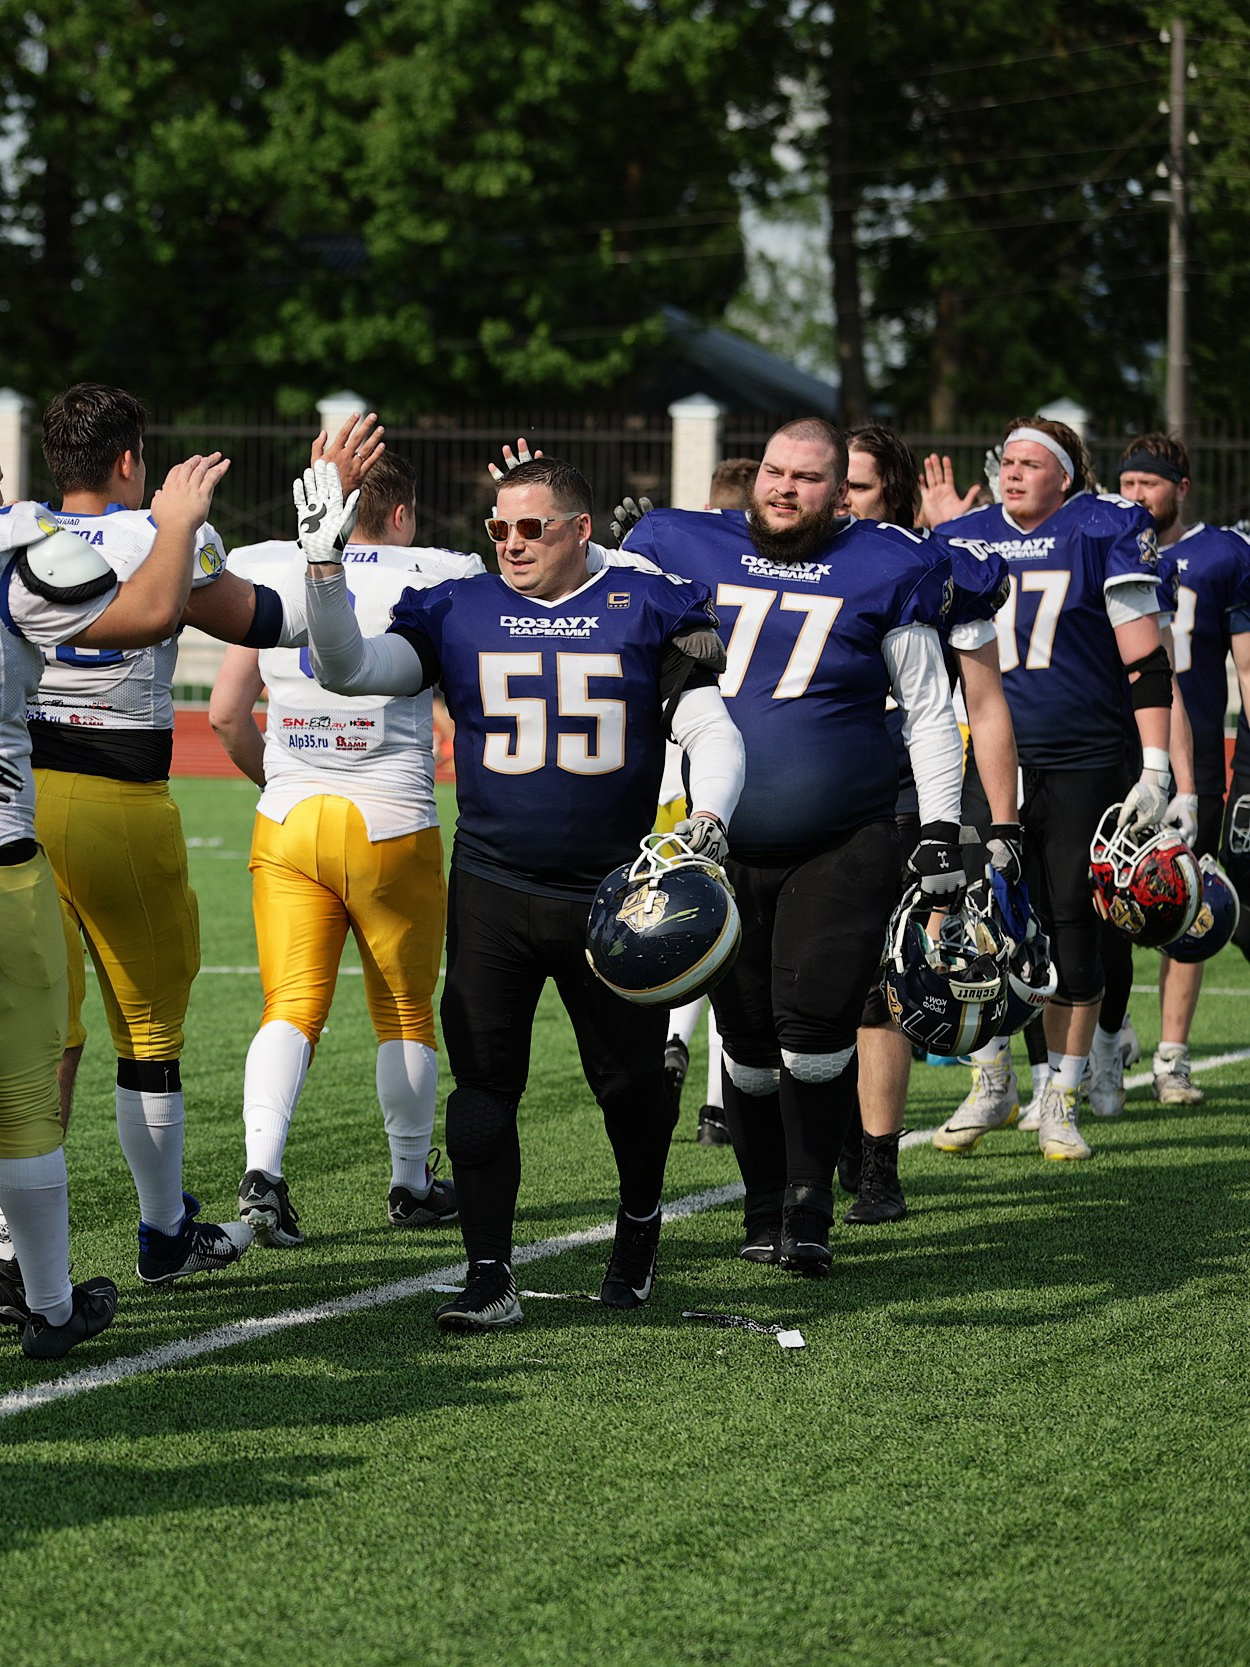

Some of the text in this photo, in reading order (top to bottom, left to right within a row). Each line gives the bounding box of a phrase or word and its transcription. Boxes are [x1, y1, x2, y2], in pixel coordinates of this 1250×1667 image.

[1001, 549, 1049, 560] АРЕЛИИ
[740, 554, 833, 576] ВОЗДУХ
[748, 566, 822, 582] КАРЕЛИИ
[500, 615, 600, 629] ВОЗДУХ
[509, 627, 591, 637] КАРЕЛИИ
[716, 584, 844, 699] 77
[478, 652, 626, 776] 55
[288, 734, 329, 750] Alp35.ru
